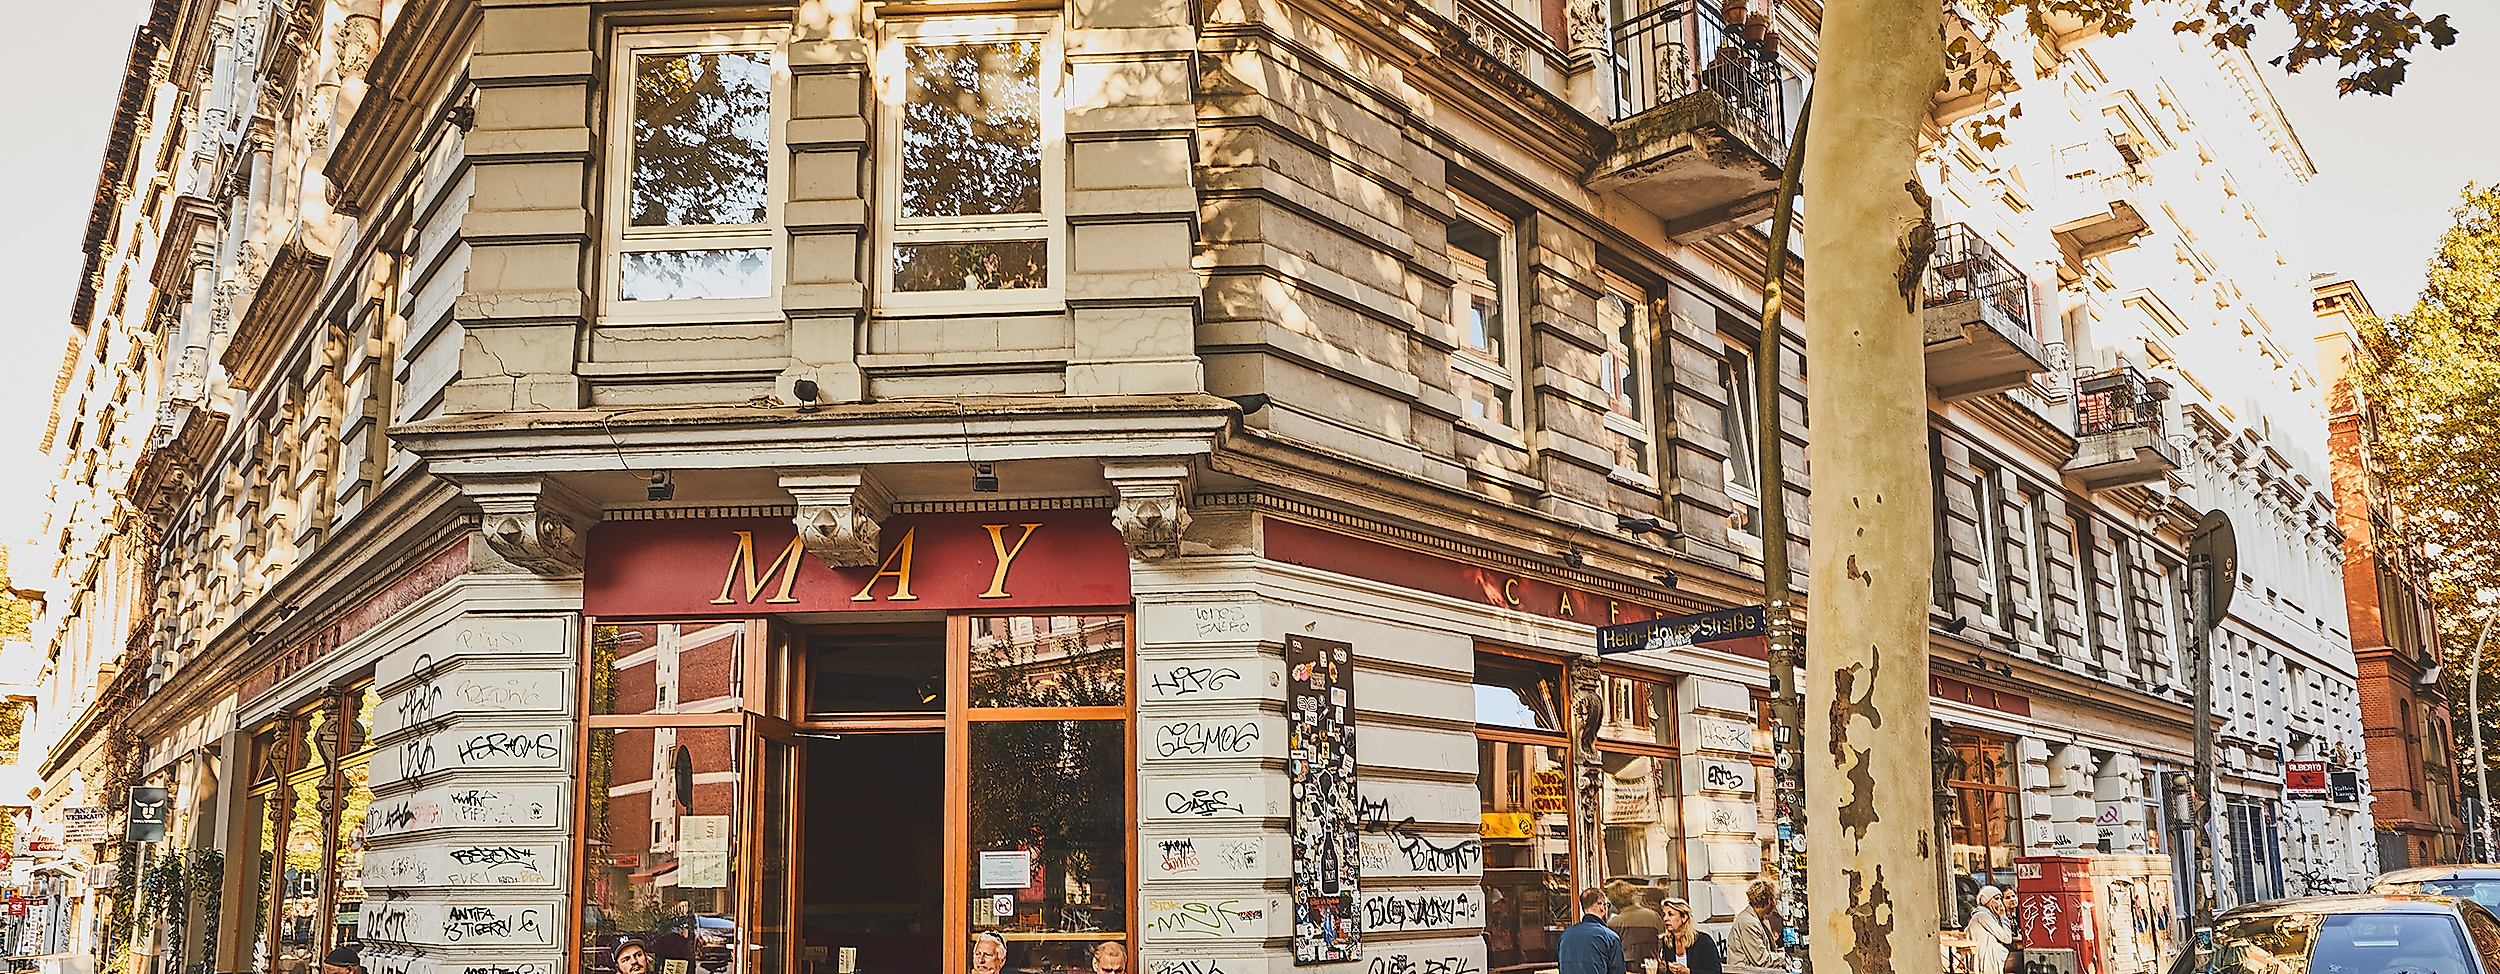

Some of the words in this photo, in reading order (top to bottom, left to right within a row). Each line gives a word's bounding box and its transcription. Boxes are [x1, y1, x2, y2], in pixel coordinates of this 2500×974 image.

[710, 522, 1043, 604] MAY
[1936, 678, 2001, 709] BAR
[2289, 763, 2322, 772] ALBERTO
[706, 818, 716, 840] MAY
[665, 961, 674, 974] AY
